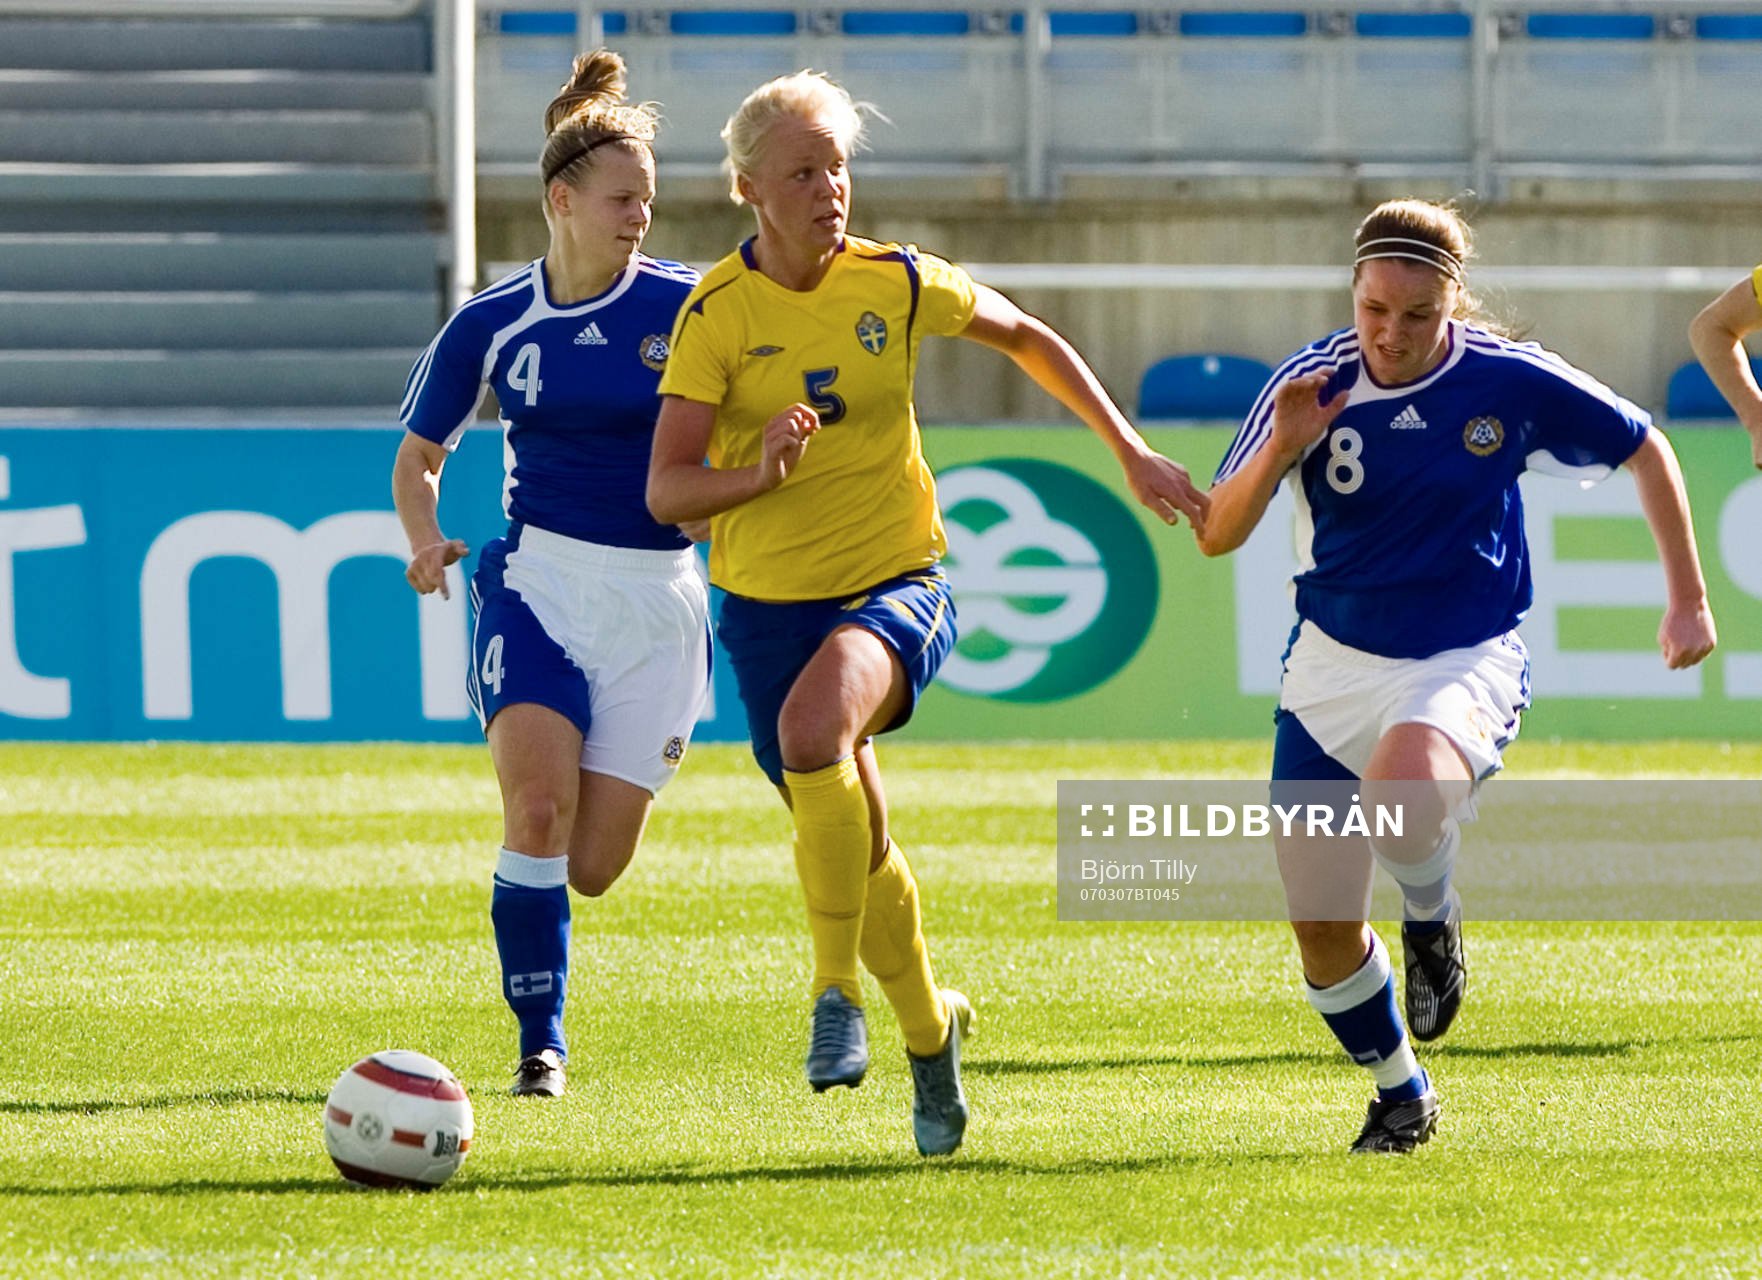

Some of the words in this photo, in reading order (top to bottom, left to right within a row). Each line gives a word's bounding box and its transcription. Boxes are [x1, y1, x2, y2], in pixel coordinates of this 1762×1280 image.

[507, 342, 543, 406] 4
[802, 366, 846, 425] 5
[1326, 427, 1364, 495] 8
[481, 634, 505, 696] 4
